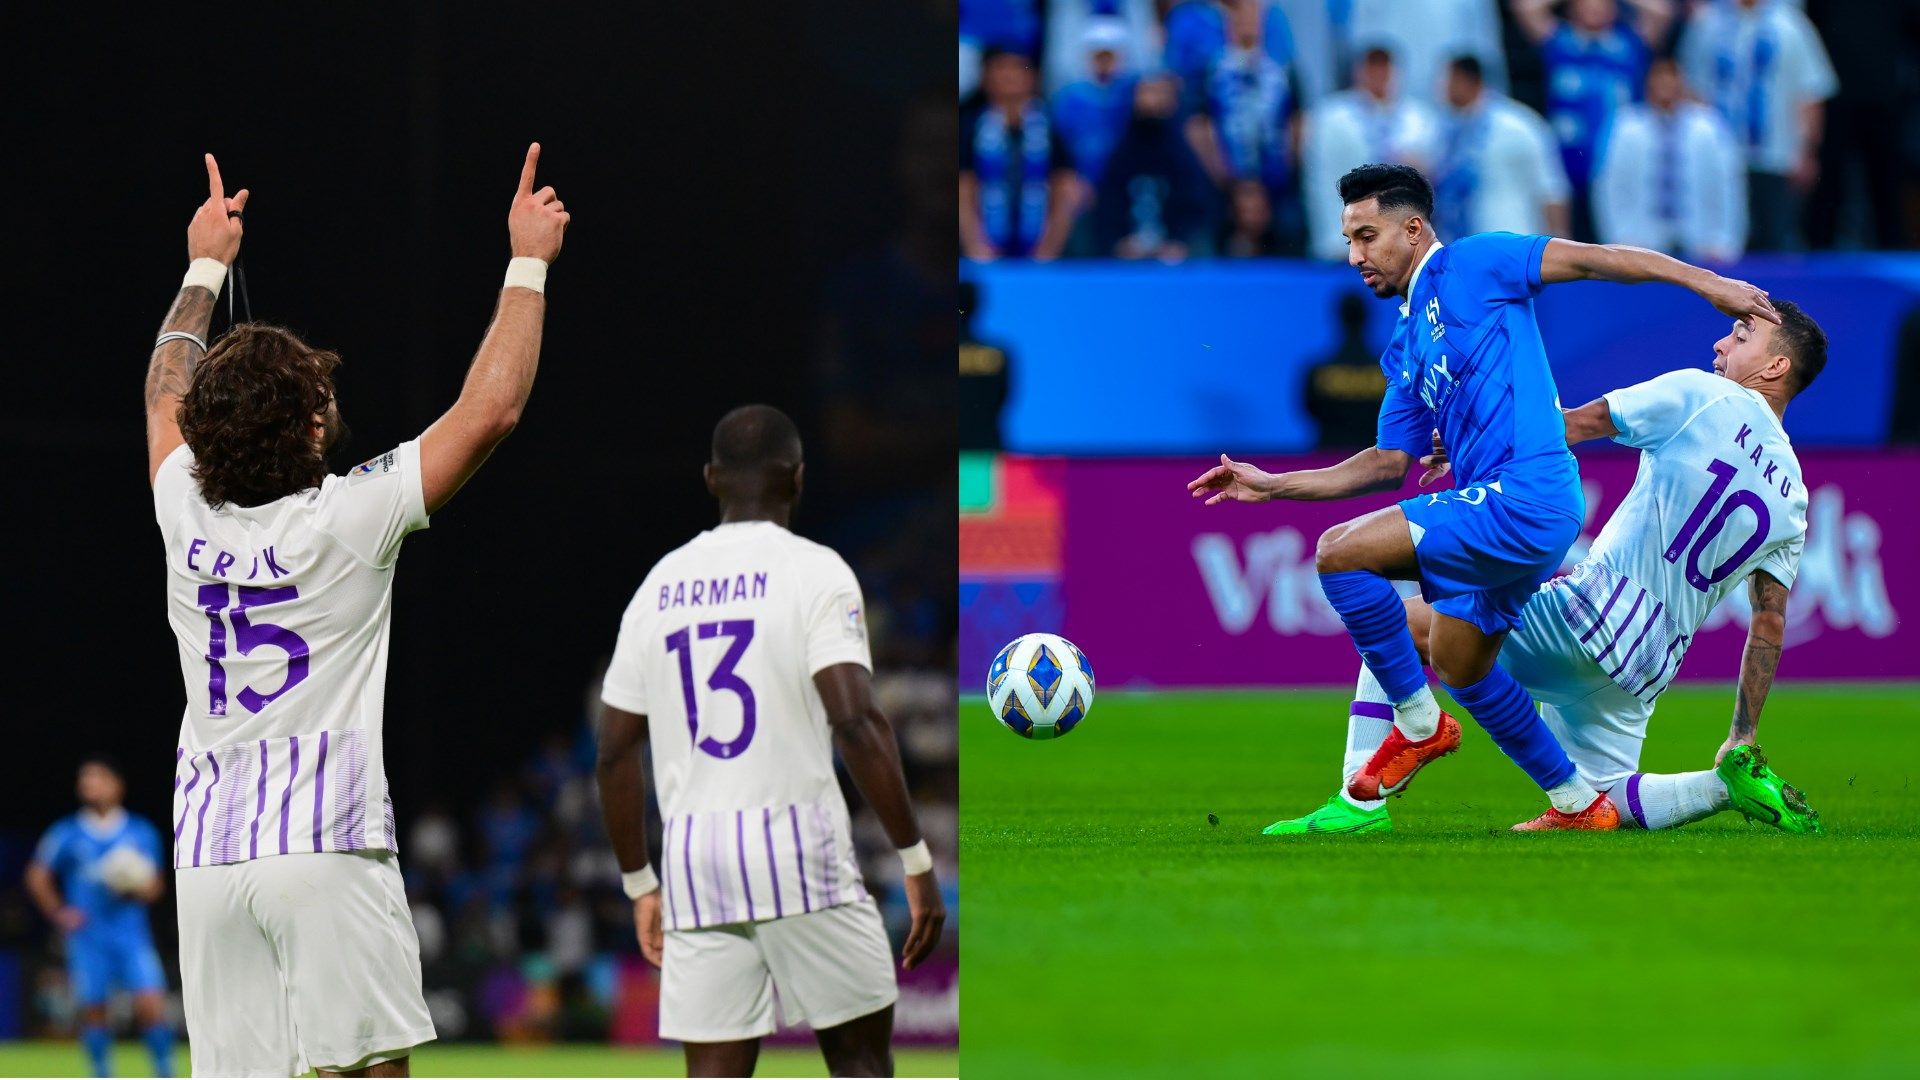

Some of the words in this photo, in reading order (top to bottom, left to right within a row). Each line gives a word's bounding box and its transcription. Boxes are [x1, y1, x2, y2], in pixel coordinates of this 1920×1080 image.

[1734, 423, 1791, 498] KAKU
[188, 538, 290, 579] ERIK
[1663, 458, 1770, 593] 10
[658, 571, 767, 611] BARMAN
[197, 582, 310, 715] 15
[665, 619, 756, 760] 13
